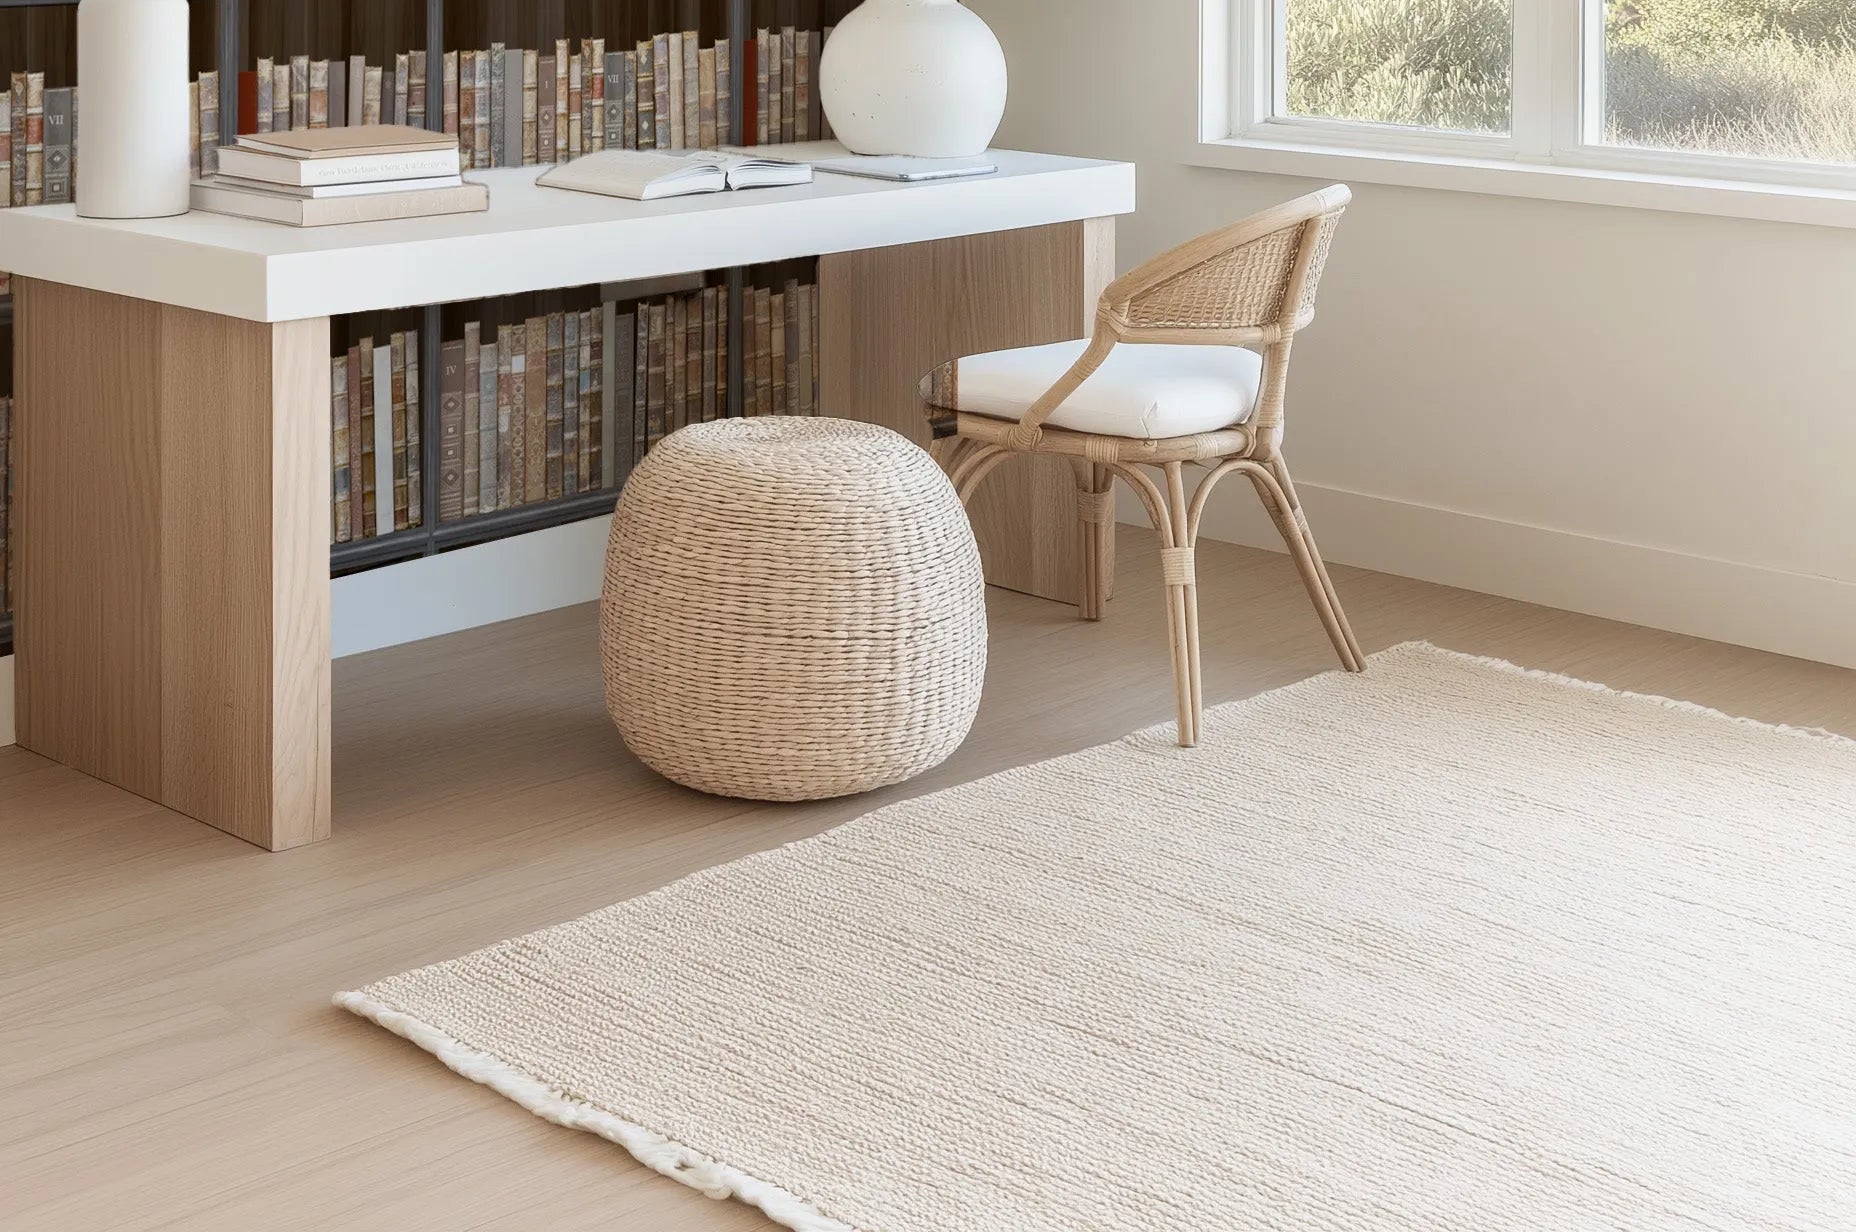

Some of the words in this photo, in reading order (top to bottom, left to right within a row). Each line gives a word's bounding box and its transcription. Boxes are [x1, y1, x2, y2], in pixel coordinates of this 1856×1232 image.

[607, 74, 619, 84] VII
[48, 114, 64, 126] VII
[445, 365, 457, 376] IV
